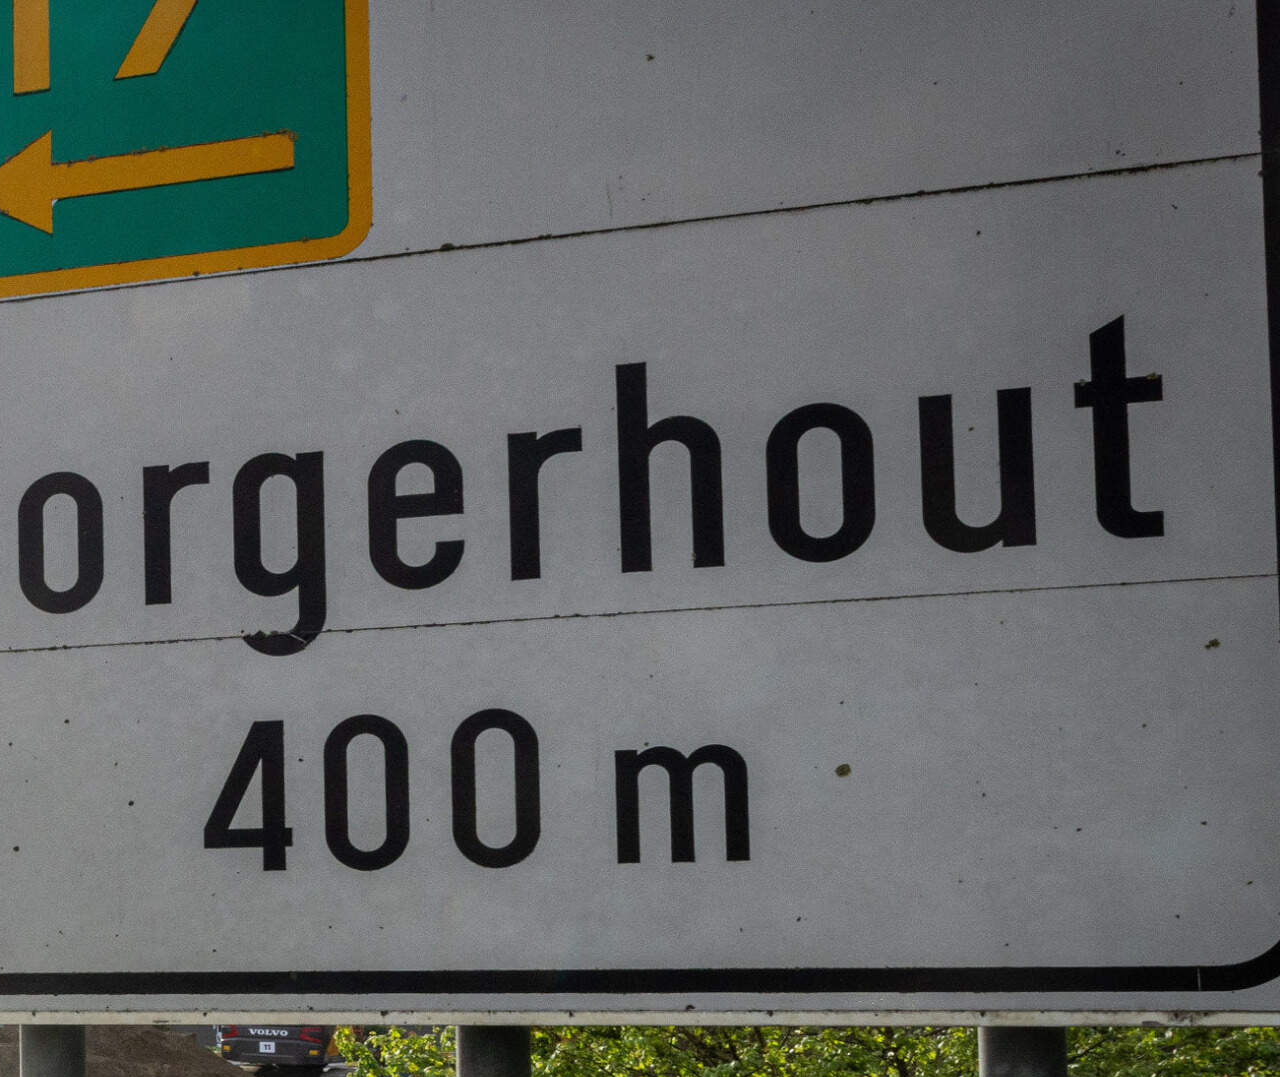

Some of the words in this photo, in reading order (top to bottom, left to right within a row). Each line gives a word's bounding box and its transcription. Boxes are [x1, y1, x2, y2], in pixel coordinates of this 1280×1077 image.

[202, 707, 542, 873] 400
[613, 742, 752, 866] m
[248, 1028, 289, 1037] VOLVO
